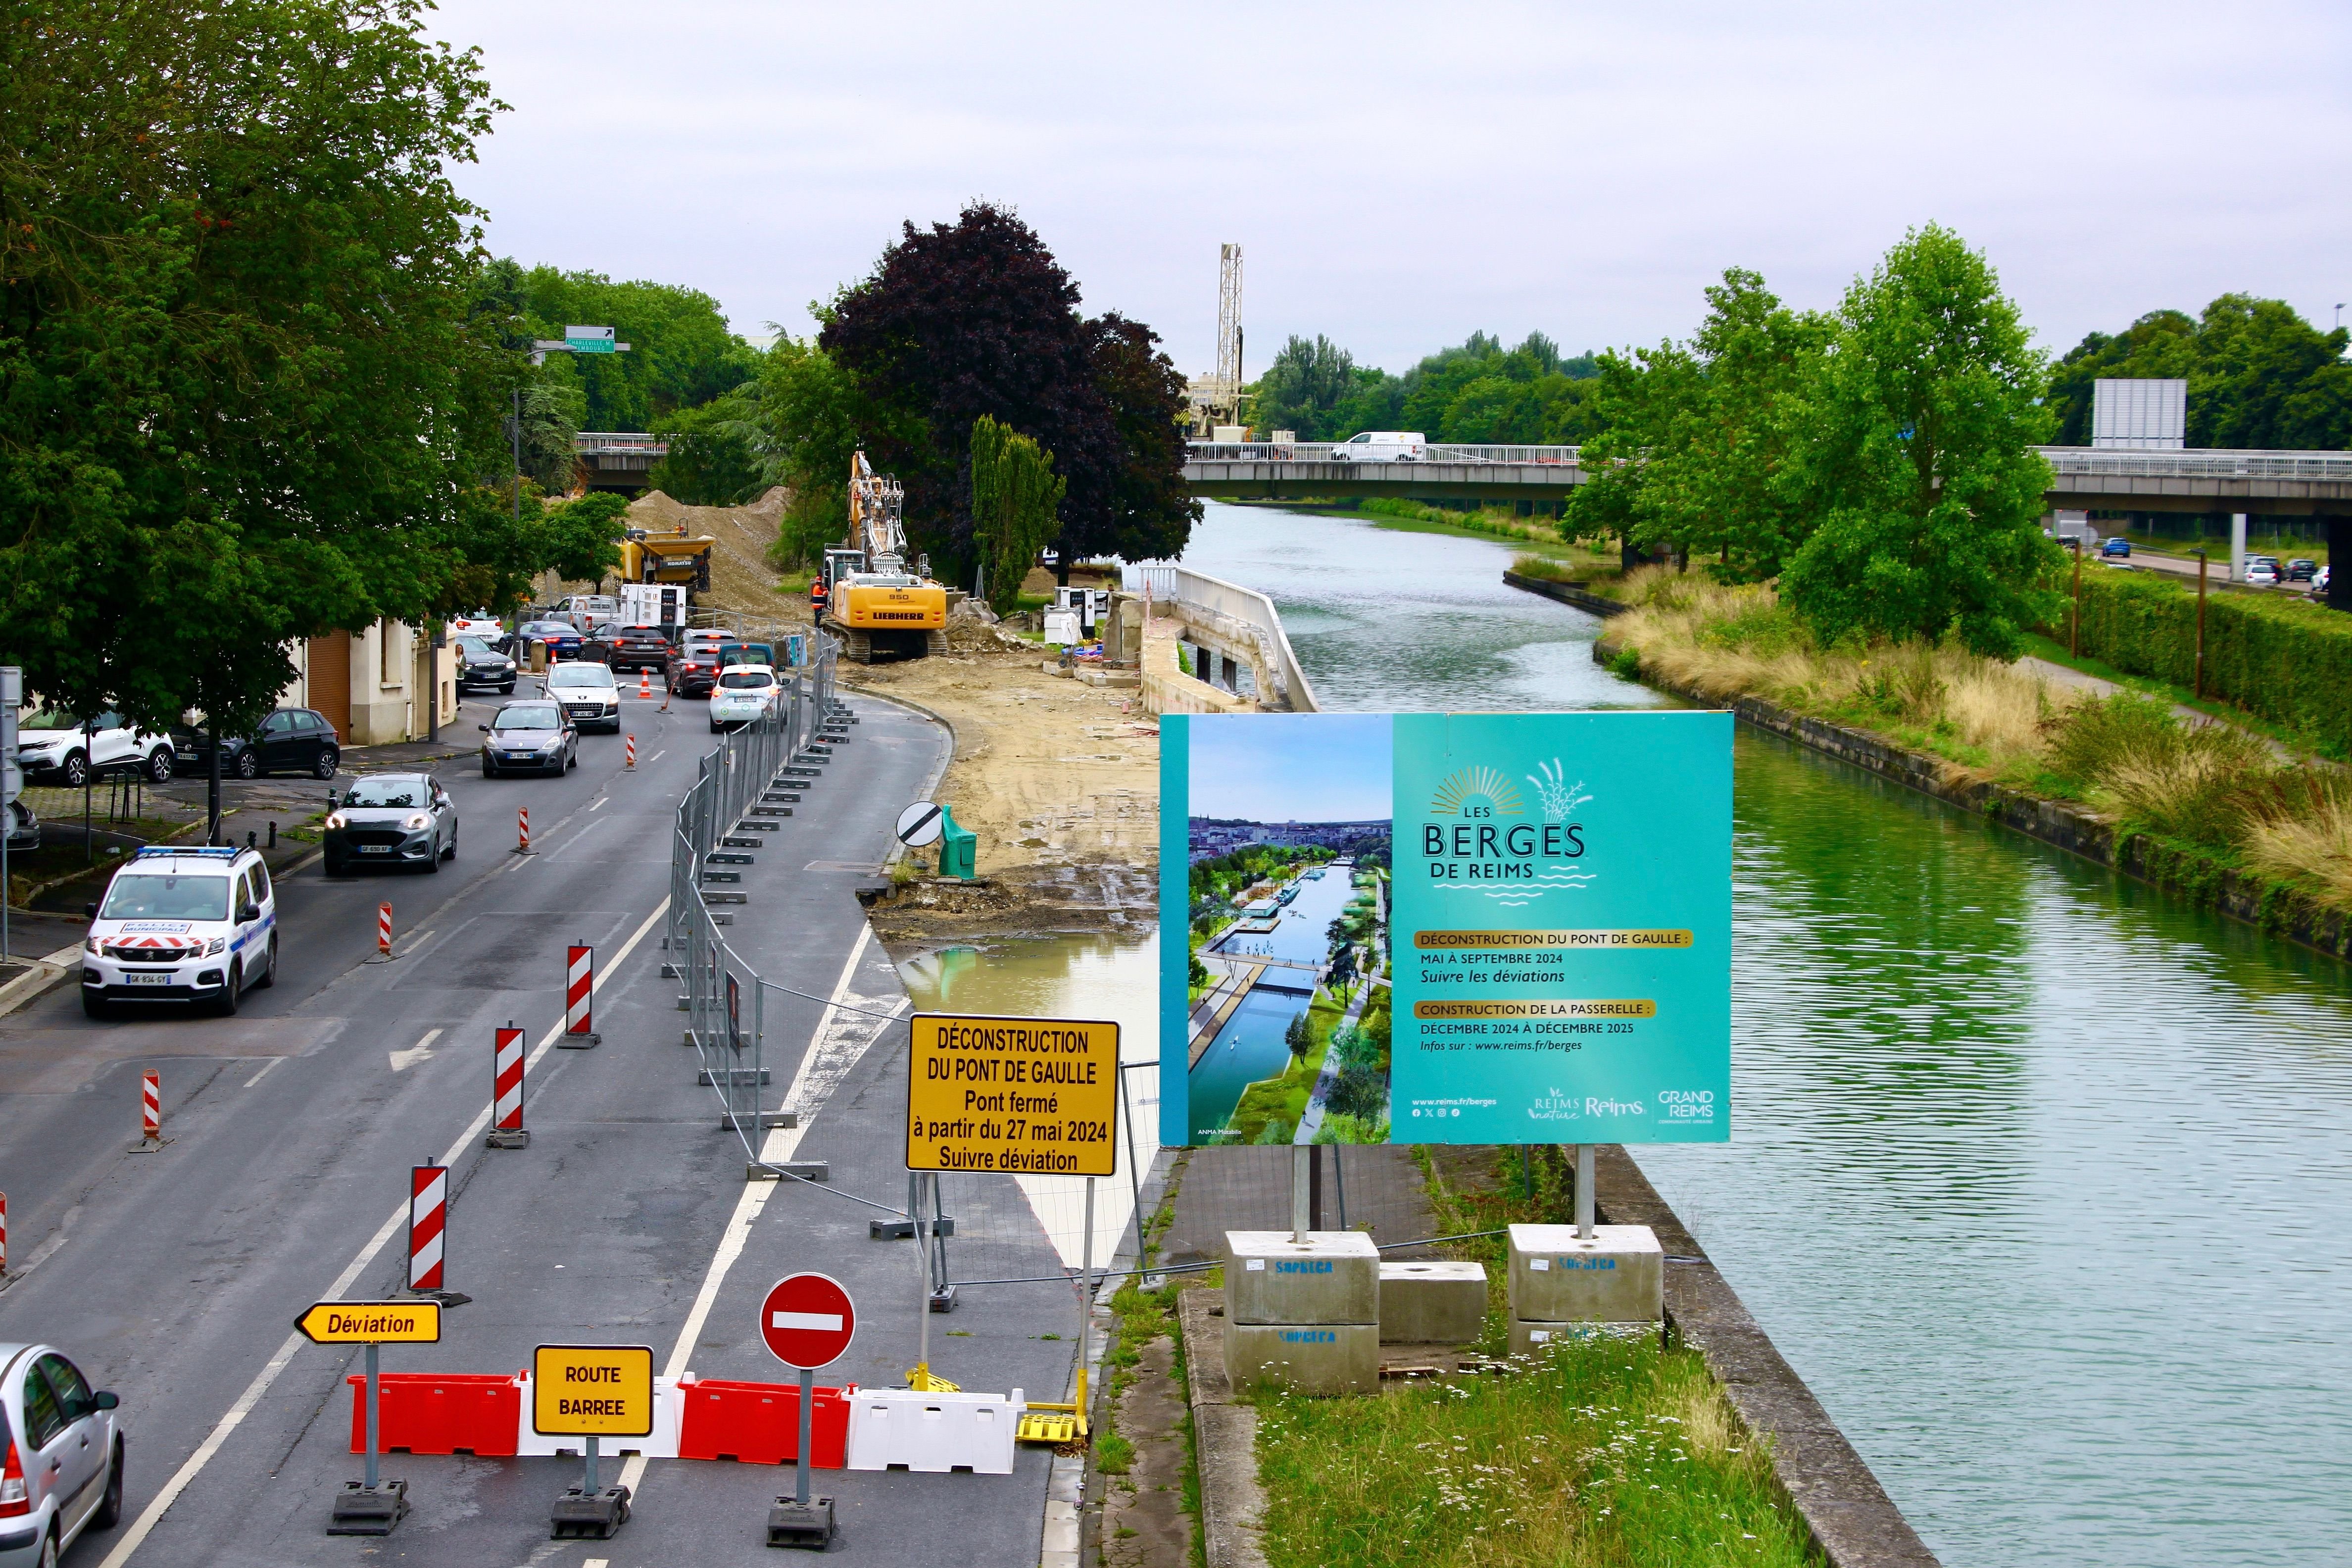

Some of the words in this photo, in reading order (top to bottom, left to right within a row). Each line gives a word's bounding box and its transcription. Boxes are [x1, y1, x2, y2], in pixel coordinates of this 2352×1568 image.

[1465, 807, 1490, 818] LES
[1423, 823, 1585, 858] BERGES
[1430, 863, 1458, 879] DE
[1469, 863, 1533, 879] REIMS
[1421, 932, 1543, 944] DÉCONSTRUCTION
[1548, 934, 1567, 944] DU
[1571, 934, 1608, 944] PONT
[1612, 934, 1628, 943] DE
[1632, 934, 1681, 943] GAULLE
[1421, 954, 1444, 964] MAI
[1448, 951, 1457, 964] À
[1461, 954, 1532, 964] SEPTEMBRE
[1536, 953, 1563, 964] 2024
[1421, 970, 1464, 982] Suivre
[1469, 970, 1487, 982] les
[1493, 969, 1565, 982] déviations
[1421, 1005, 1525, 1015] CONSTRUCTION
[1530, 1005, 1546, 1014] DE
[1551, 1005, 1567, 1014] LA
[1571, 1004, 1643, 1014] PASSERELLE
[1421, 1022, 1488, 1034] DÉCEMBRE
[1492, 1024, 1519, 1034] 2024
[1522, 1022, 1532, 1033] À
[1536, 1021, 1603, 1033] DÉCEMBRE
[1607, 1024, 1633, 1033] 2025
[938, 1022, 1088, 1053] DÉCONSTRUCTION
[1421, 1040, 1445, 1052] Infos
[1475, 1040, 1582, 1052] www.reims.fr/berges
[928, 1057, 950, 1080] DU
[956, 1058, 1000, 1081] PONT
[1005, 1060, 1026, 1082] DE
[1031, 1061, 1096, 1084] GAULLE
[965, 1090, 1004, 1112] Pont
[1010, 1091, 1058, 1113] fermé
[1412, 1097, 1497, 1107] www.reims.fr/berges
[1535, 1098, 1579, 1109] REIMS
[1659, 1091, 1714, 1103] GRAND
[1533, 1109, 1580, 1121] nature
[1670, 1105, 1714, 1117] REIMS
[914, 1116, 923, 1137] à
[929, 1117, 975, 1142] partir
[980, 1118, 1001, 1139] du
[1006, 1119, 1026, 1140] 27
[1032, 1120, 1062, 1141] mai
[1068, 1121, 1107, 1142] 2024
[939, 1146, 993, 1168] Suivre
[999, 1148, 1078, 1171] déviation
[327, 1313, 414, 1333] Déviation
[565, 1366, 621, 1383] ROUTE
[559, 1399, 626, 1416] BARREE
